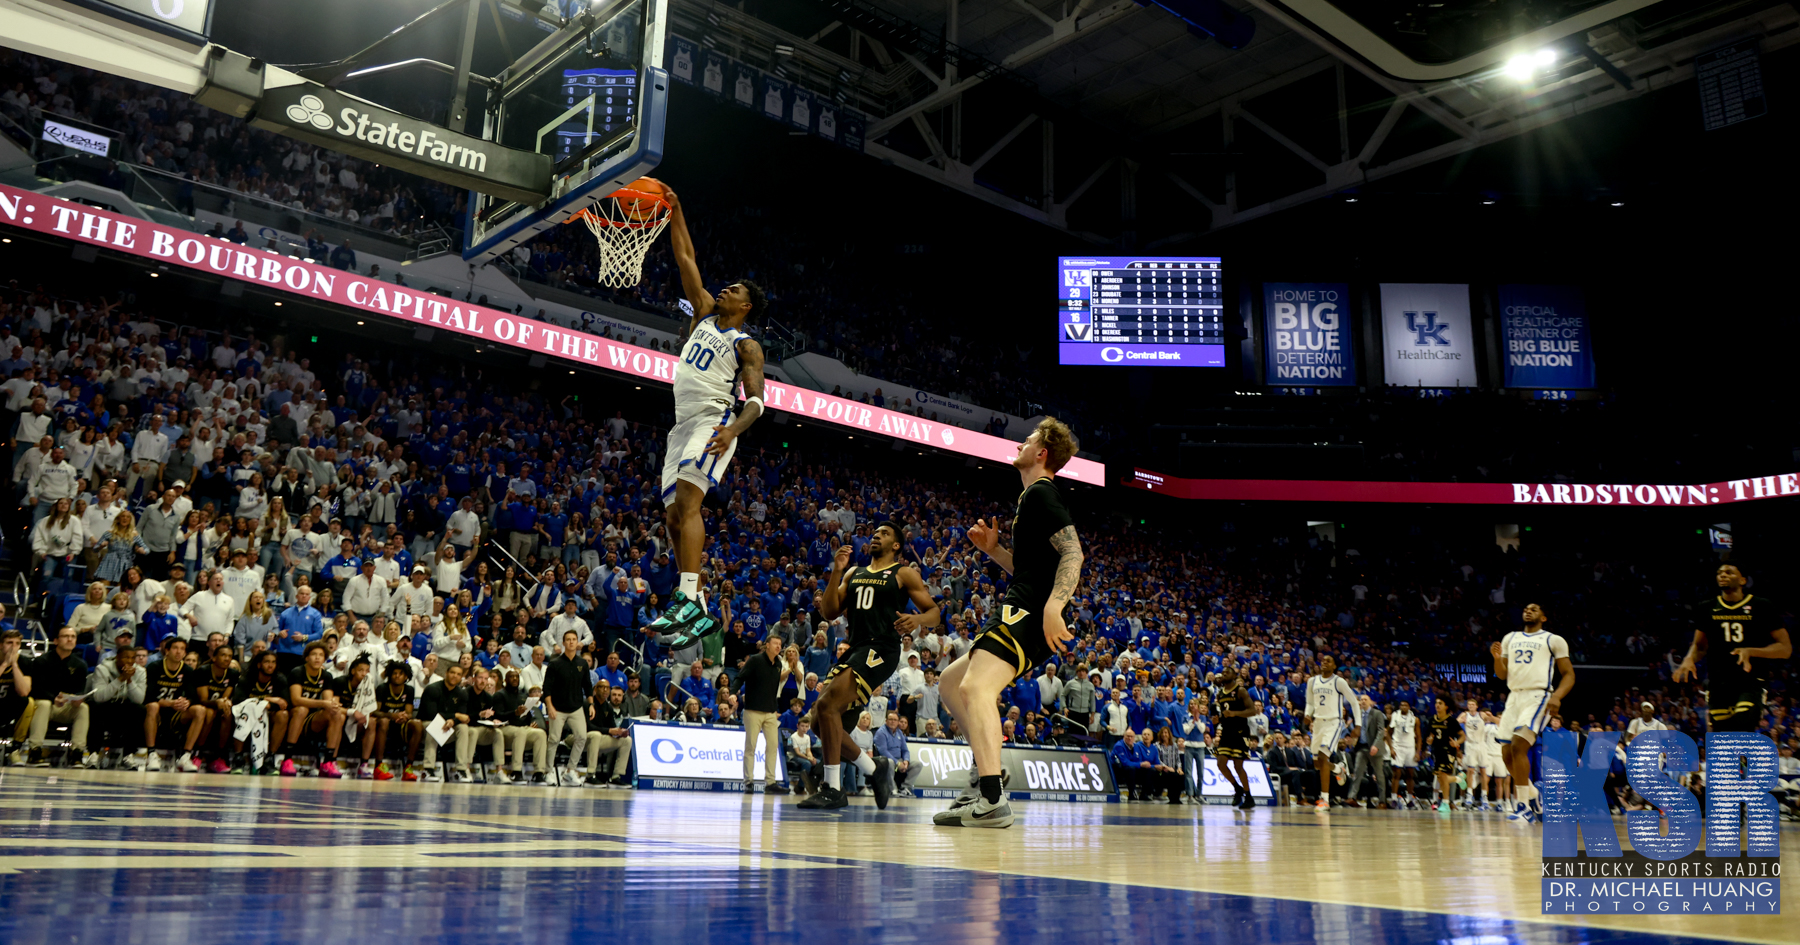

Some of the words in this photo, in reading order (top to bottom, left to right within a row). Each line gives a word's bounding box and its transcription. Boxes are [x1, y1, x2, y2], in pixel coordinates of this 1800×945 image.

[679, 61, 687, 70] 00
[52, 206, 136, 248] THE
[150, 231, 336, 297] BOURBON
[347, 282, 484, 333] CAPITAL
[494, 318, 534, 344] OF
[542, 329, 599, 361] THE
[1070, 287, 1080, 298] 29
[1274, 290, 1316, 301] HOME
[1319, 290, 1339, 301] TO
[1275, 302, 1340, 330] BIG
[1505, 305, 1558, 316] OFFICIAL
[1070, 313, 1080, 323] 16
[1507, 317, 1583, 328] HEALTHCARE
[597, 317, 617, 328] Central
[617, 323, 631, 332] Bank
[632, 326, 647, 336] Loge
[1403, 310, 1451, 346] UK
[1508, 328, 1559, 338] PARTNER
[1561, 328, 1579, 338] OF
[1276, 331, 1341, 350] BLUE
[1509, 340, 1536, 352] BIG
[1540, 340, 1580, 352] BLUE
[686, 342, 715, 371] 00
[1126, 351, 1157, 359] Central
[1158, 352, 1181, 360] Bank
[1276, 352, 1342, 365] DETERMI
[1397, 350, 1461, 361] HealthCare
[1510, 354, 1573, 366] NATION
[929, 396, 947, 407] Central
[948, 401, 960, 410] Bank
[961, 405, 973, 414] Loge
[790, 392, 806, 411] A
[811, 397, 872, 427] POUR
[878, 414, 933, 441] AWAY
[1512, 484, 1720, 504] BARDSTOWN:
[1728, 473, 1800, 501] THE
[851, 578, 887, 586] VANDERBILT
[855, 585, 875, 610] 10
[1002, 604, 1030, 626] V
[1720, 621, 1745, 643] 13
[1511, 641, 1543, 650] KENTUCKY
[866, 648, 885, 668] V
[1514, 649, 1534, 664] 23
[1461, 663, 1487, 673] PHONE
[1461, 673, 1487, 683] DOWN
[159, 687, 177, 699] 25
[1320, 695, 1326, 706] 2
[688, 747, 732, 761] Central
[736, 750, 765, 762] Bnk
[918, 747, 974, 785] MALO
[653, 779, 679, 790] KENTUCKY
[680, 781, 693, 790] FARM
[694, 782, 713, 791] BUREAU
[723, 782, 732, 791] BIG
[732, 782, 741, 791] ON
[923, 789, 941, 798] KENTUCKY
[942, 789, 952, 798] FARM
